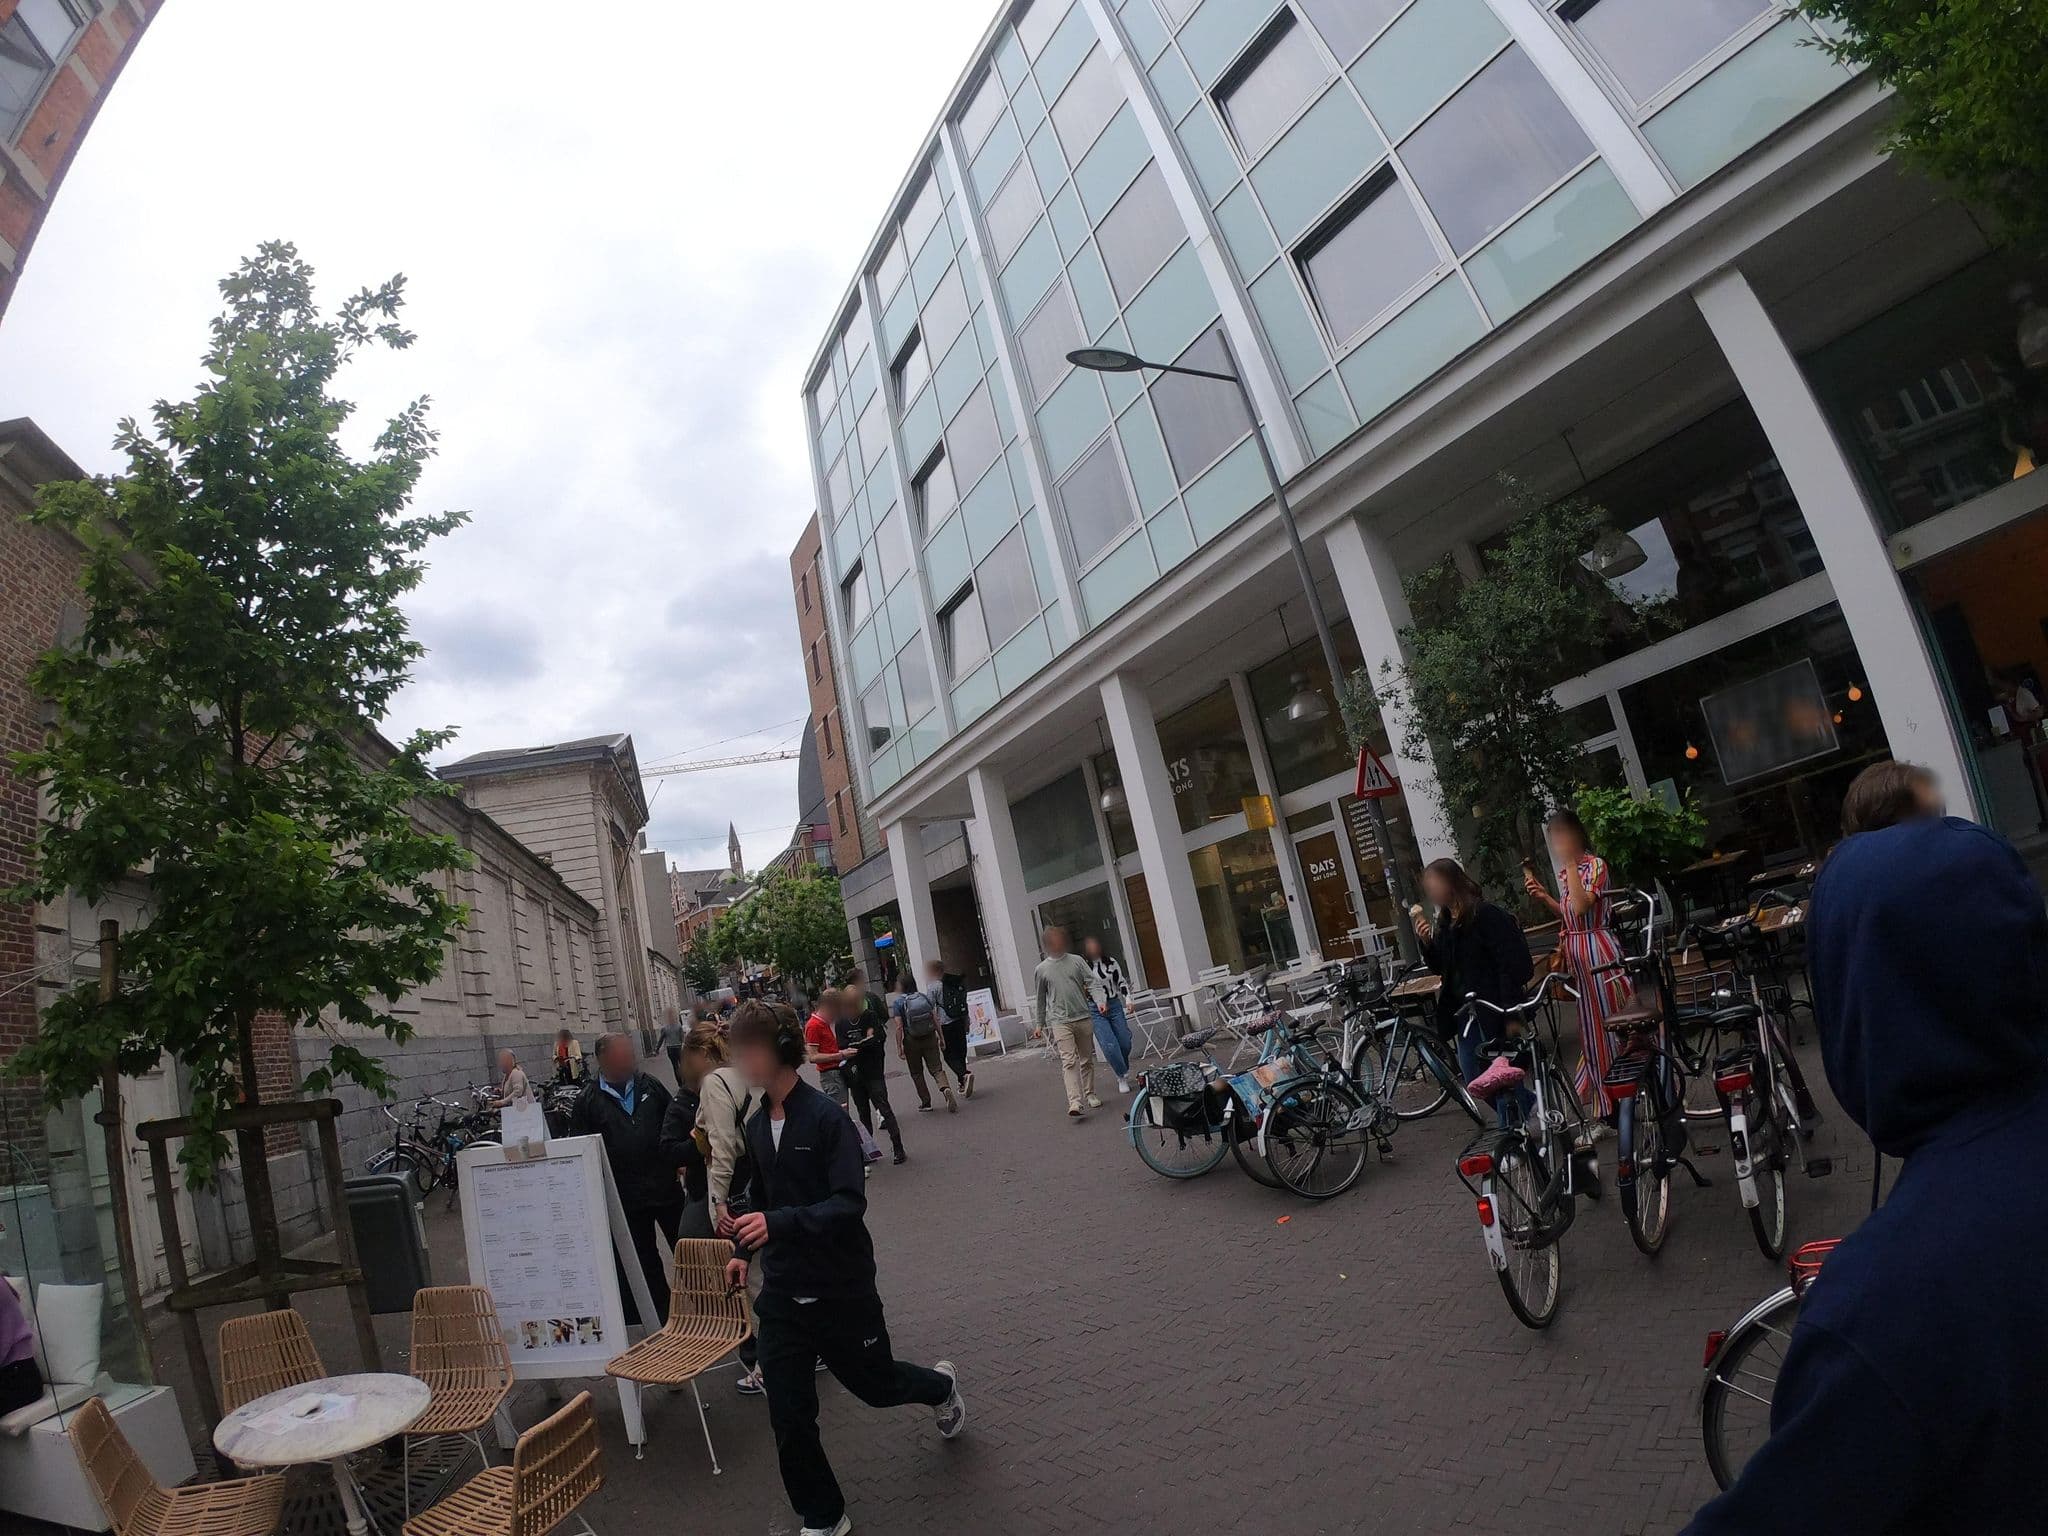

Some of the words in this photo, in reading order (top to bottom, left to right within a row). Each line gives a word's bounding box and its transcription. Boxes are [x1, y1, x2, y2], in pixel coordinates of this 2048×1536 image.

[1168, 758, 1190, 782] ATS
[1172, 780, 1193, 796] ONG
[1309, 858, 1336, 875] OATS
[1323, 871, 1337, 879] LONG
